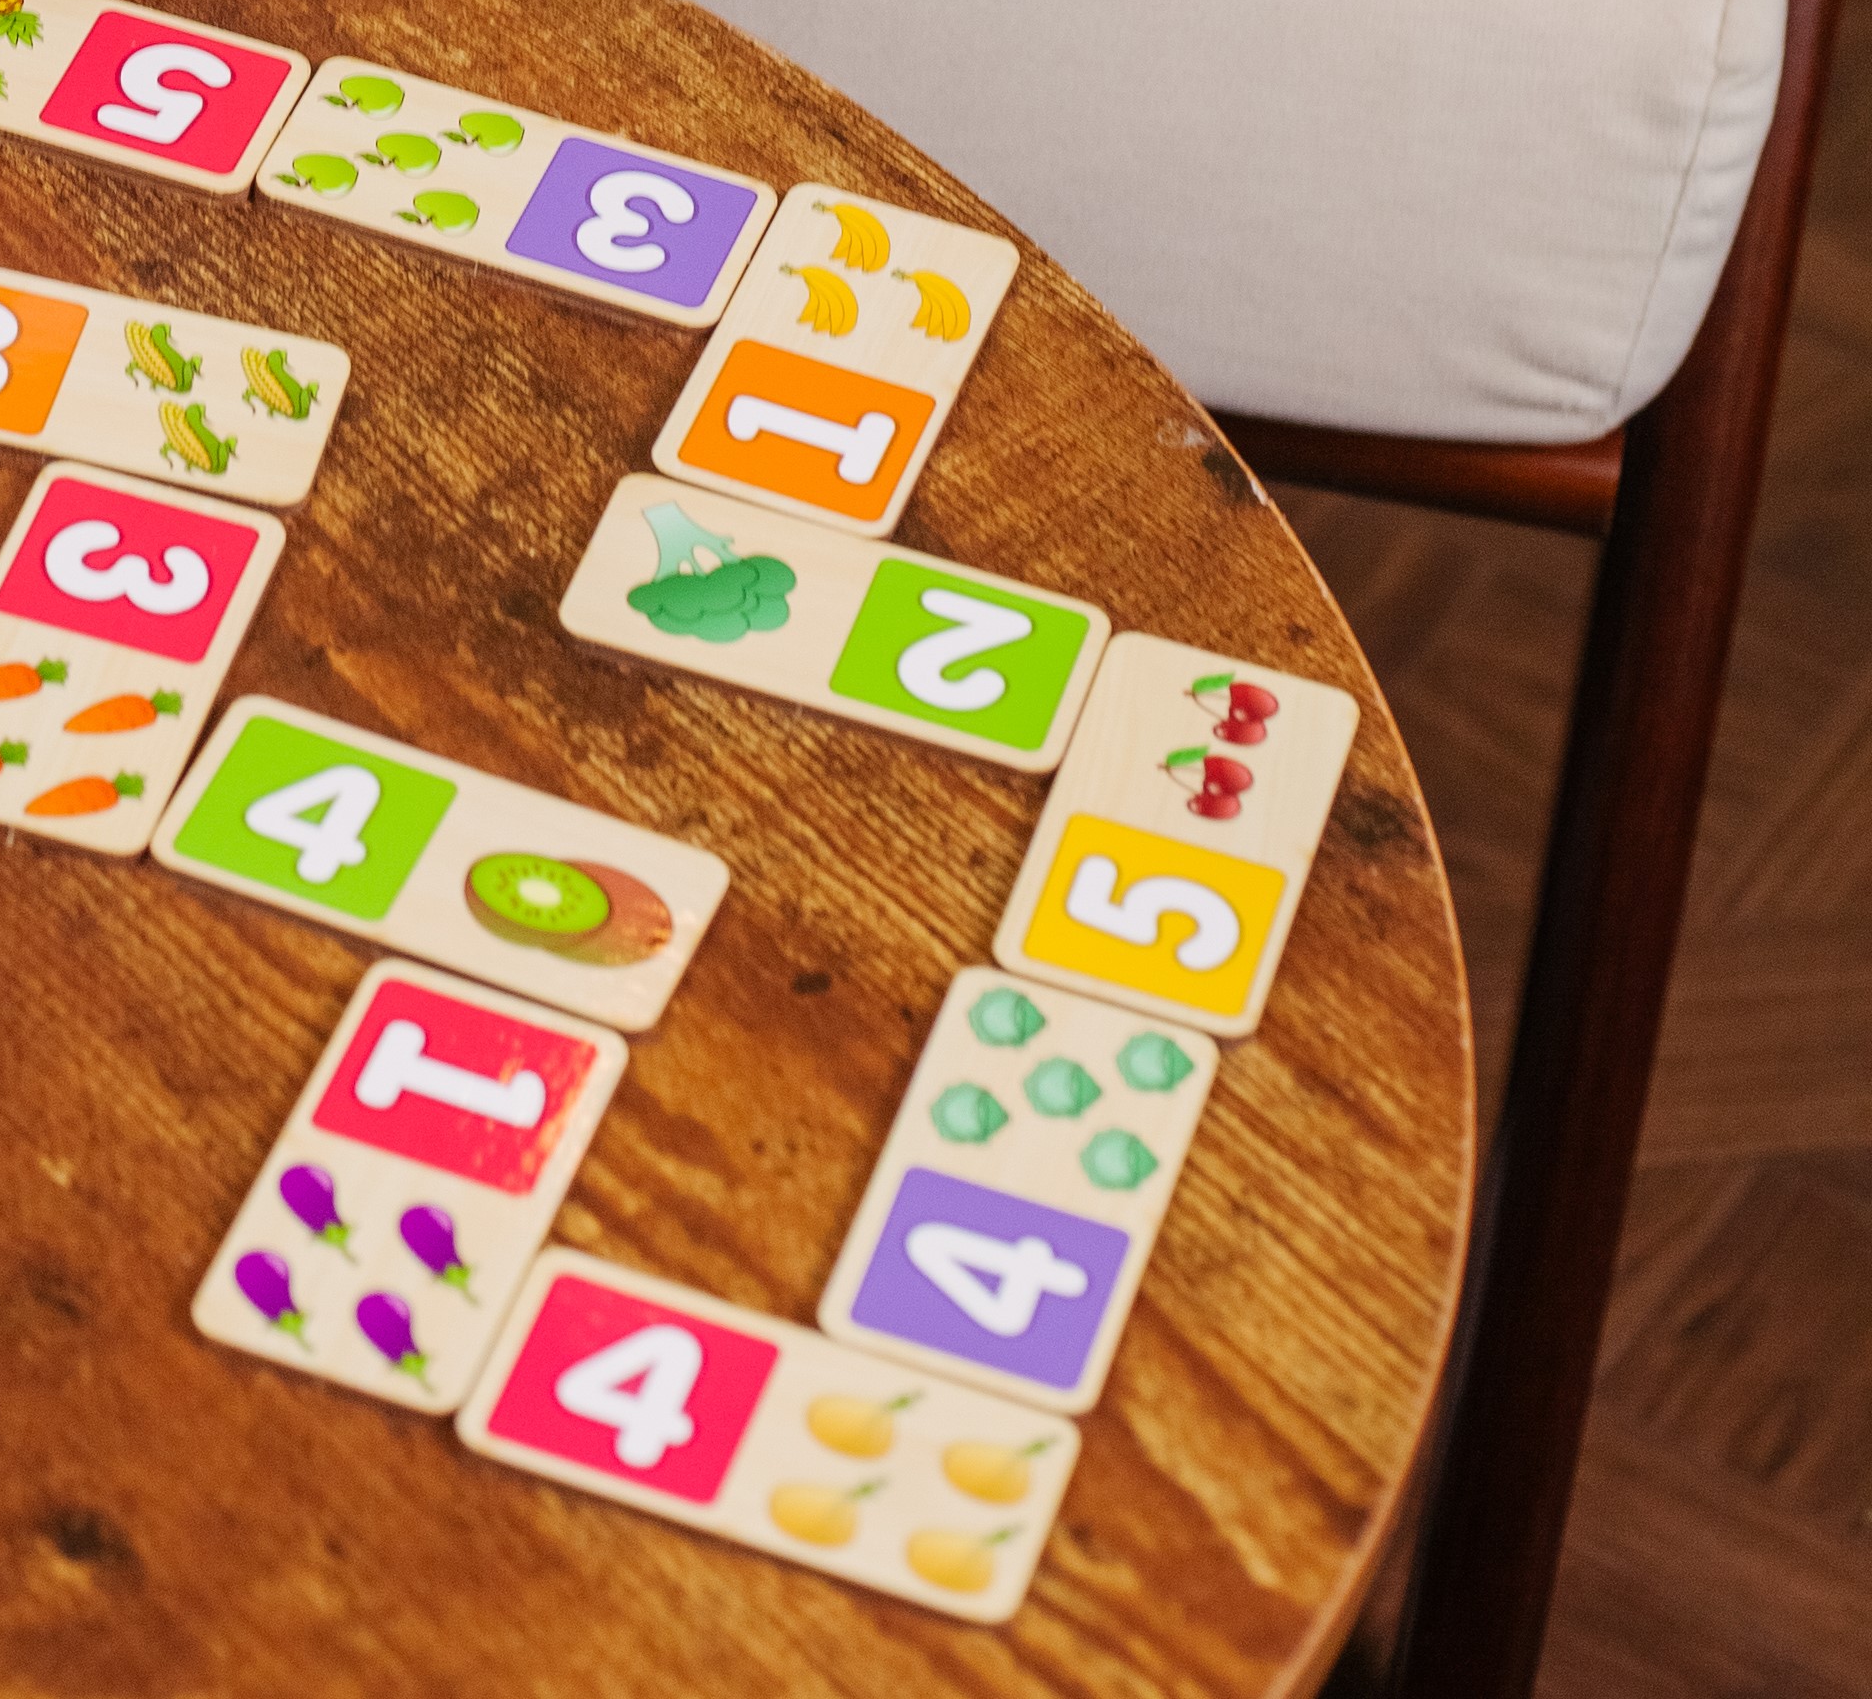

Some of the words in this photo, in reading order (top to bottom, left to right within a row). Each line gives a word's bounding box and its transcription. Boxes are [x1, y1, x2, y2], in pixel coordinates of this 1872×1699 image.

[97, 44, 231, 143] 5
[576, 170, 695, 272] 3
[728, 395, 894, 484] 1
[46, 521, 208, 613] 3
[898, 589, 1031, 710] 2
[246, 765, 380, 882] 4
[1067, 857, 1238, 969] 5
[356, 1021, 544, 1126] 1
[906, 1223, 1088, 1336] 4
[557, 1325, 700, 1467] 4
